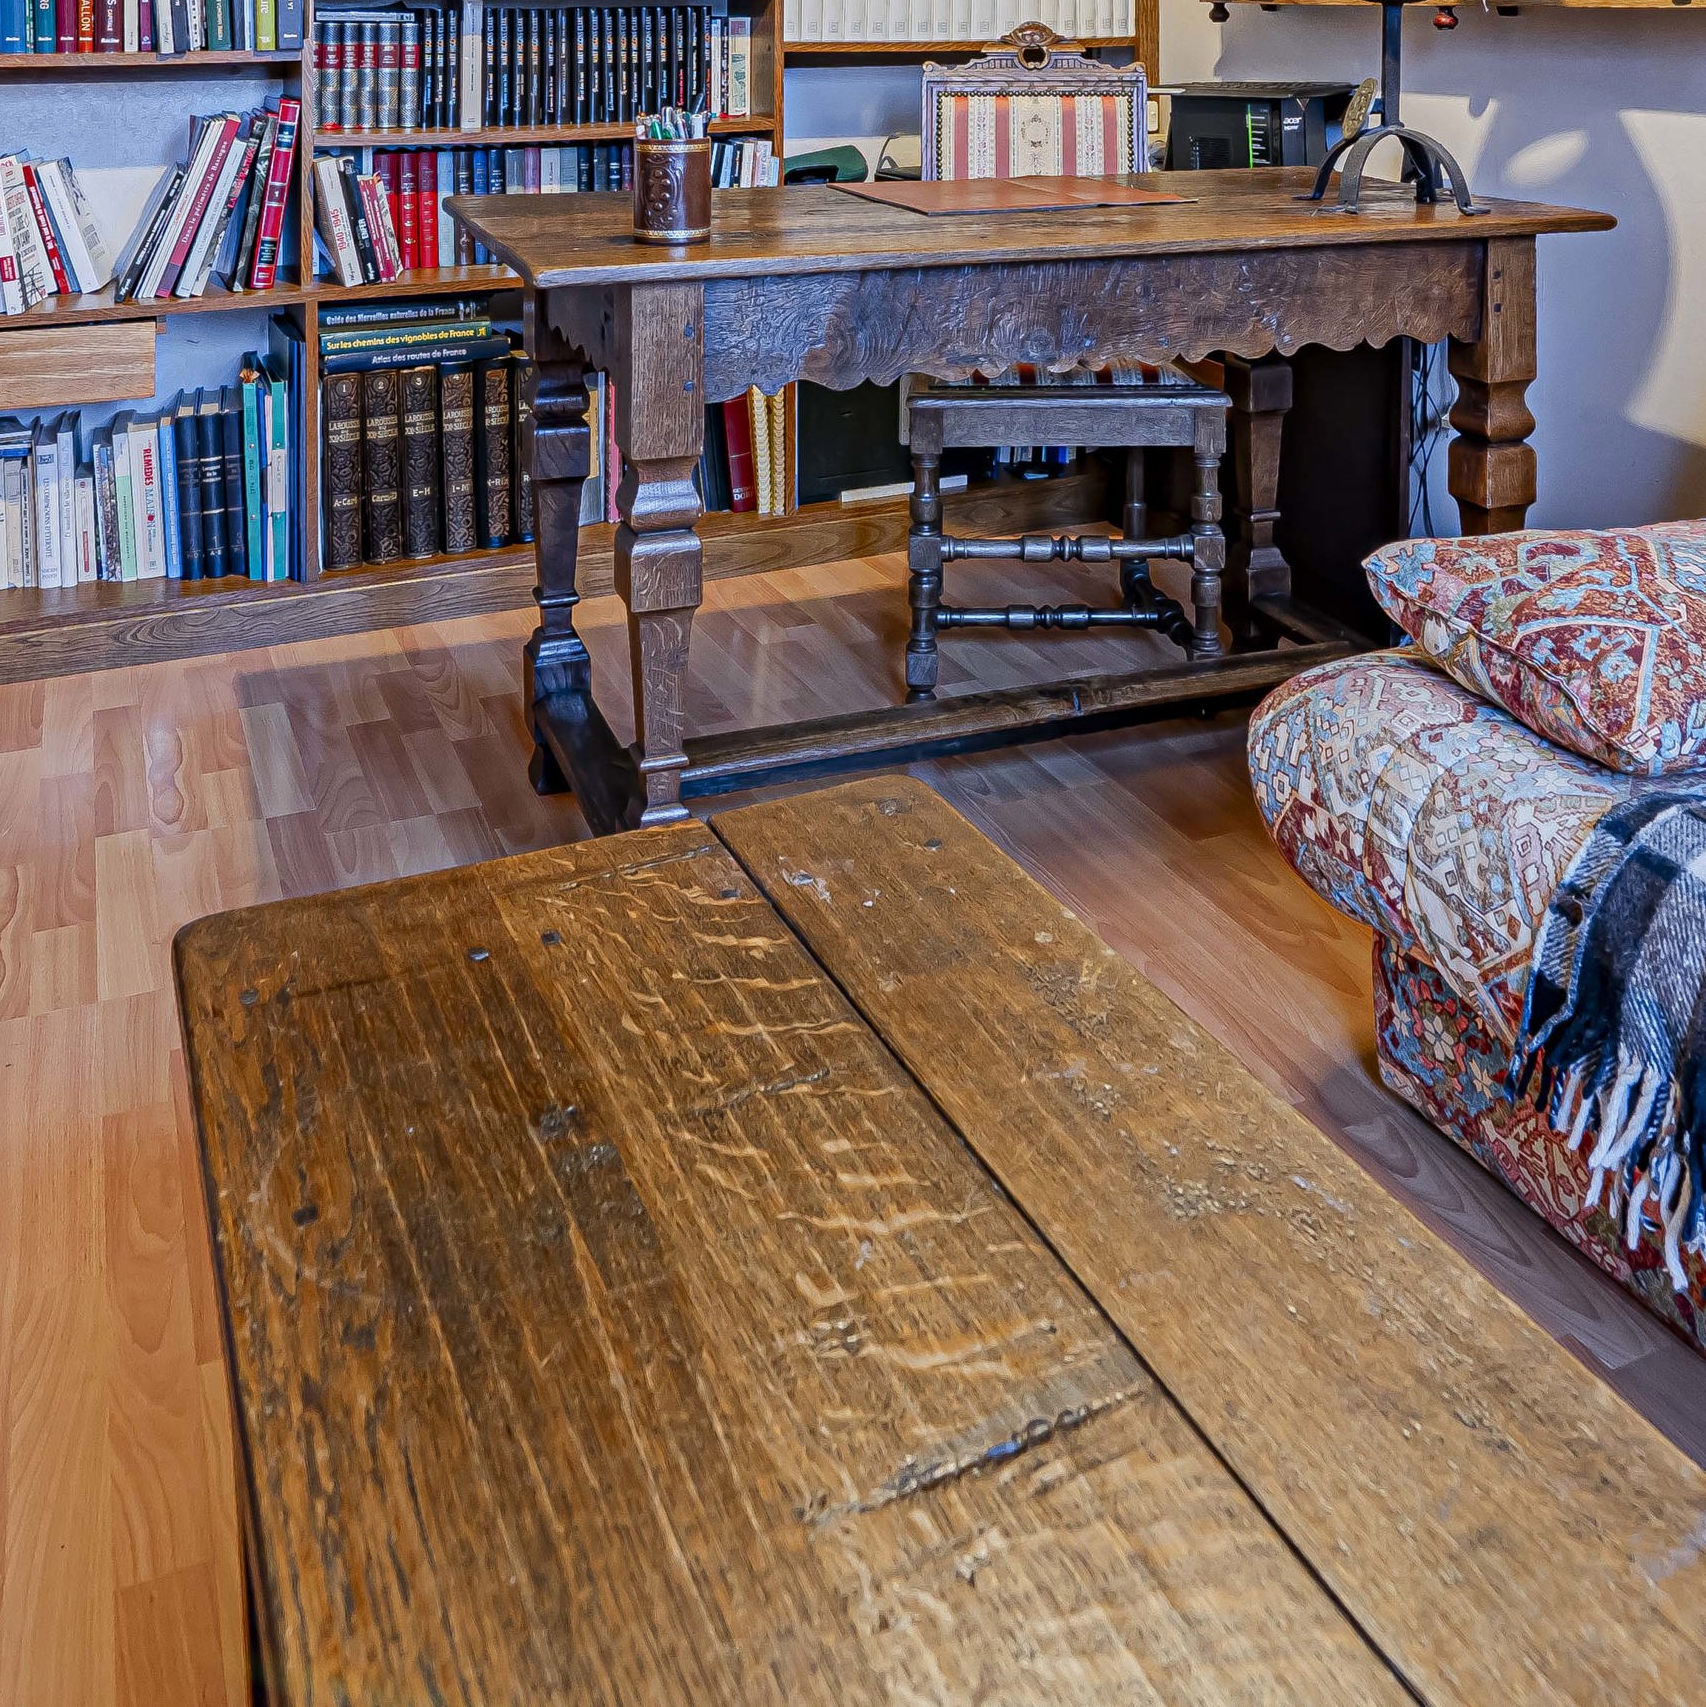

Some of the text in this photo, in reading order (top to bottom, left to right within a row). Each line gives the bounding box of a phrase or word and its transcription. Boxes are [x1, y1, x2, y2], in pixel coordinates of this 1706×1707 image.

[181, 226, 193, 243] Dans
[206, 173, 214, 181] de
[327, 342, 339, 350] Sur
[340, 340, 351, 348] les
[353, 338, 384, 348] chemins
[386, 336, 399, 345] des
[401, 333, 440, 343] vignobles
[450, 329, 474, 338] France
[372, 348, 467, 364] Atlas des routes de France
[415, 378, 422, 386] 3
